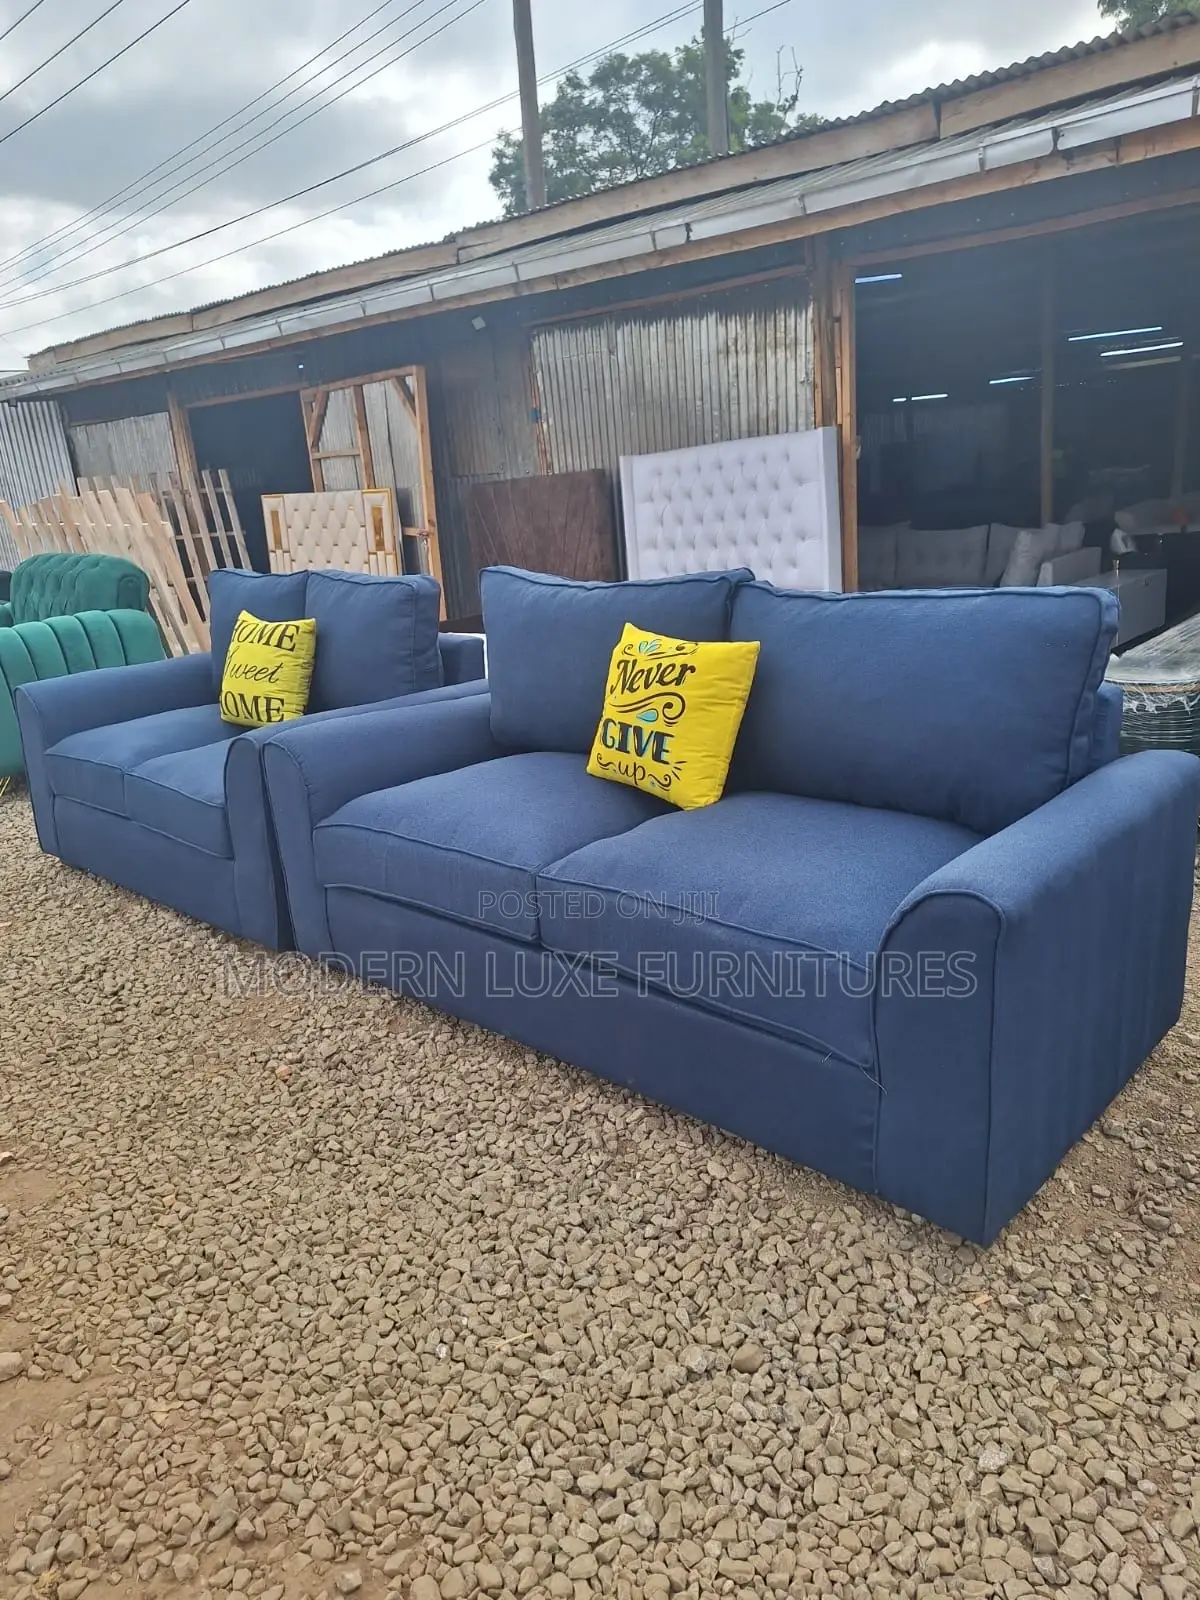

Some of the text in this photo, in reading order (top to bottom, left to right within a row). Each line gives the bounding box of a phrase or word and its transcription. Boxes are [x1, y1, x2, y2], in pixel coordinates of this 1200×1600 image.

[610, 658, 696, 696] Never
[220, 690, 285, 723] OME
[601, 717, 675, 765] GIVE
[617, 760, 646, 786] up
